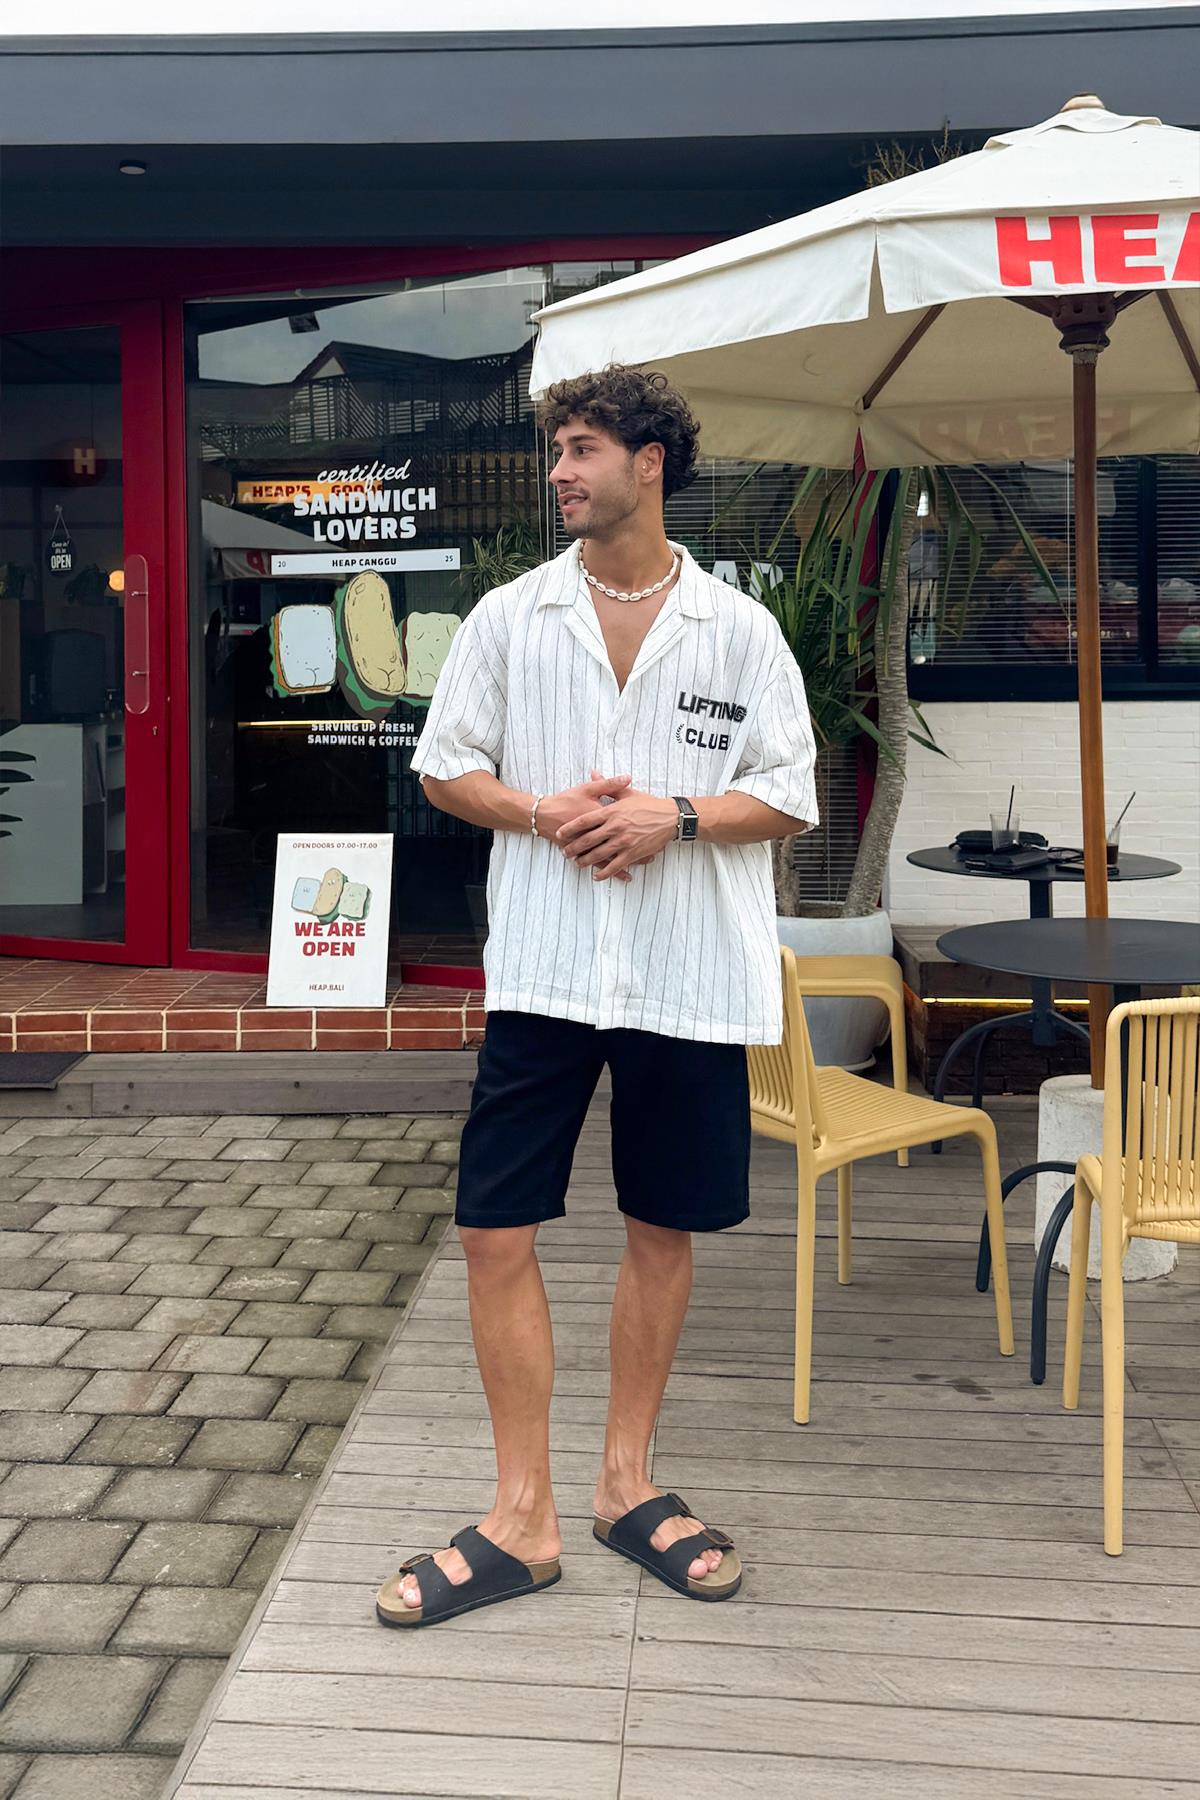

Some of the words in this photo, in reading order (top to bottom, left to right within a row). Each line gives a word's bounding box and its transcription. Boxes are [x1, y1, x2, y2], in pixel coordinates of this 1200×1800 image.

[317, 459, 411, 492] certified
[294, 488, 436, 516] SANDWICH
[313, 516, 416, 542] LOVERS
[51, 554, 71, 569] OPEN
[359, 558, 397, 566] CANGGU
[678, 691, 747, 722] LIFTING
[311, 723, 359, 732] SERVING
[362, 723, 376, 732] UP
[379, 723, 414, 732] FRESH
[308, 735, 365, 745] SANDWICH
[368, 736, 376, 747] &
[379, 736, 418, 746] COFFEE
[686, 728, 729, 750] CLUB
[295, 922, 323, 936] WE
[327, 922, 366, 936] ARE
[303, 941, 355, 956] OPEN
